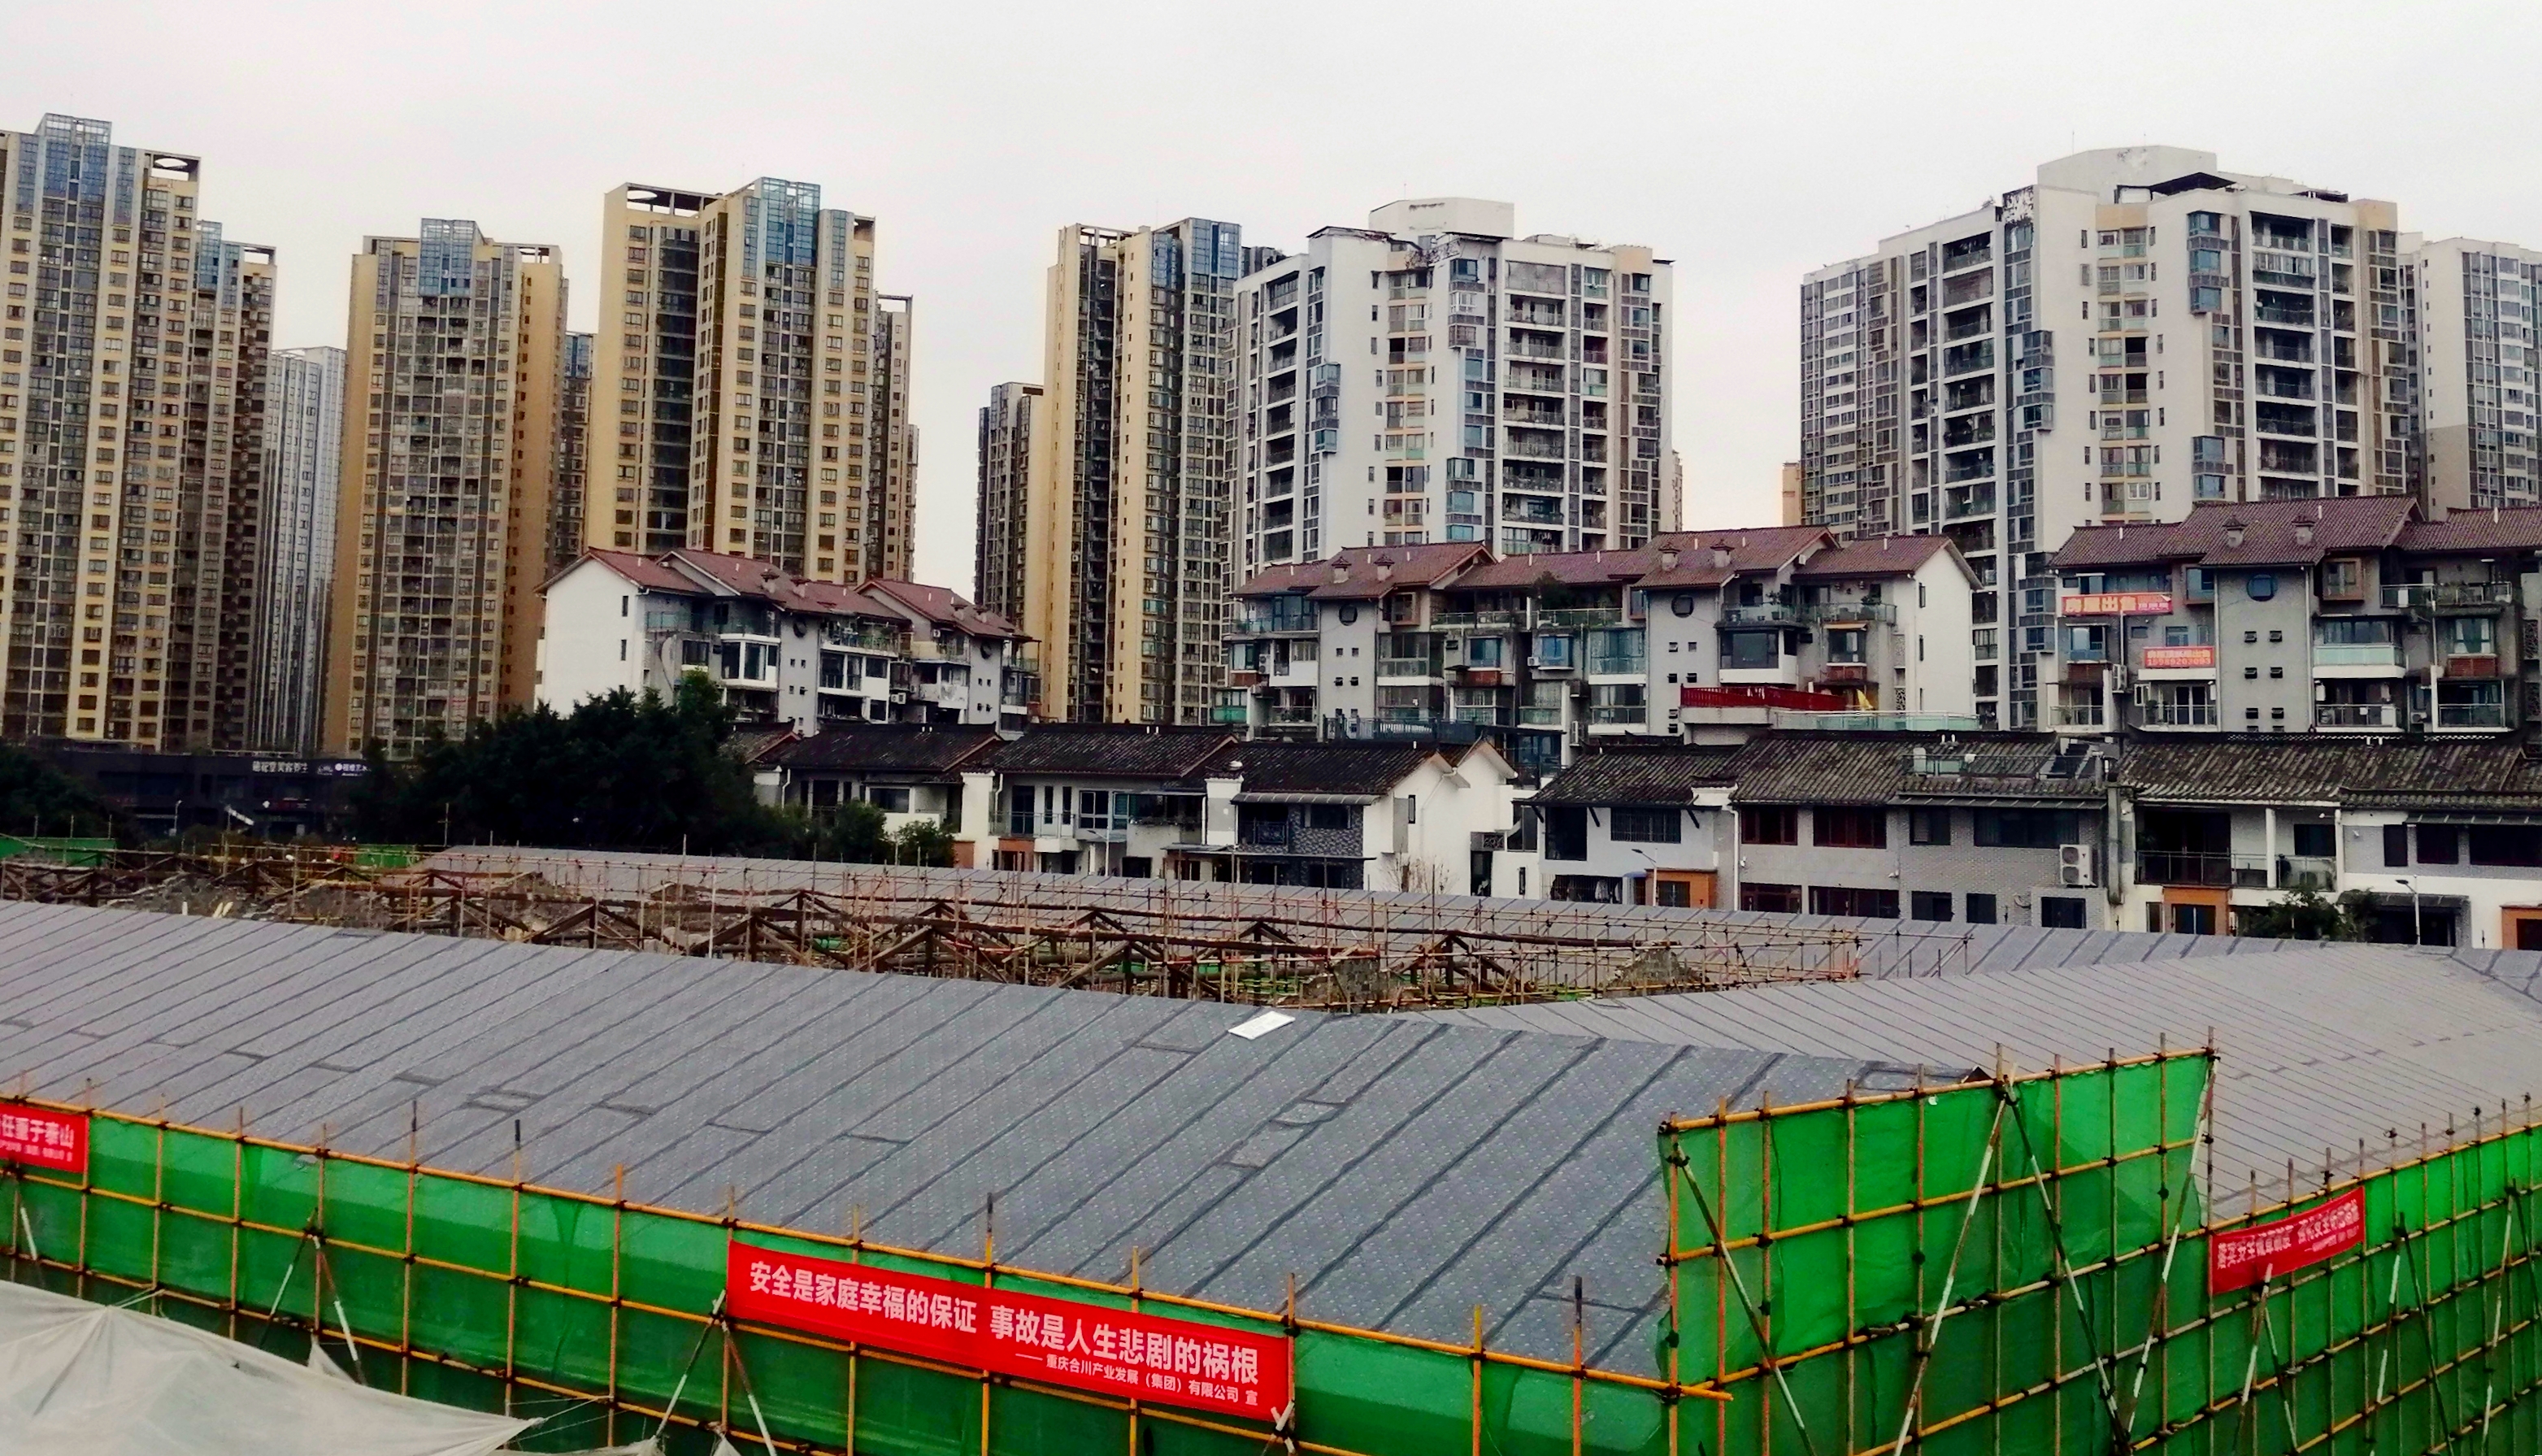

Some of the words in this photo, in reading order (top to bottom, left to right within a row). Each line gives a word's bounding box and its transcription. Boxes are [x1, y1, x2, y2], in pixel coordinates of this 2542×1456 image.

[2066, 596, 2137, 613] 房屋出售
[750, 1260, 977, 1334] 安全是家庭幸福的保证
[989, 1304, 1259, 1384] 事故是人生悲剧的祸根
[1245, 1389, 1258, 1406] 宣
